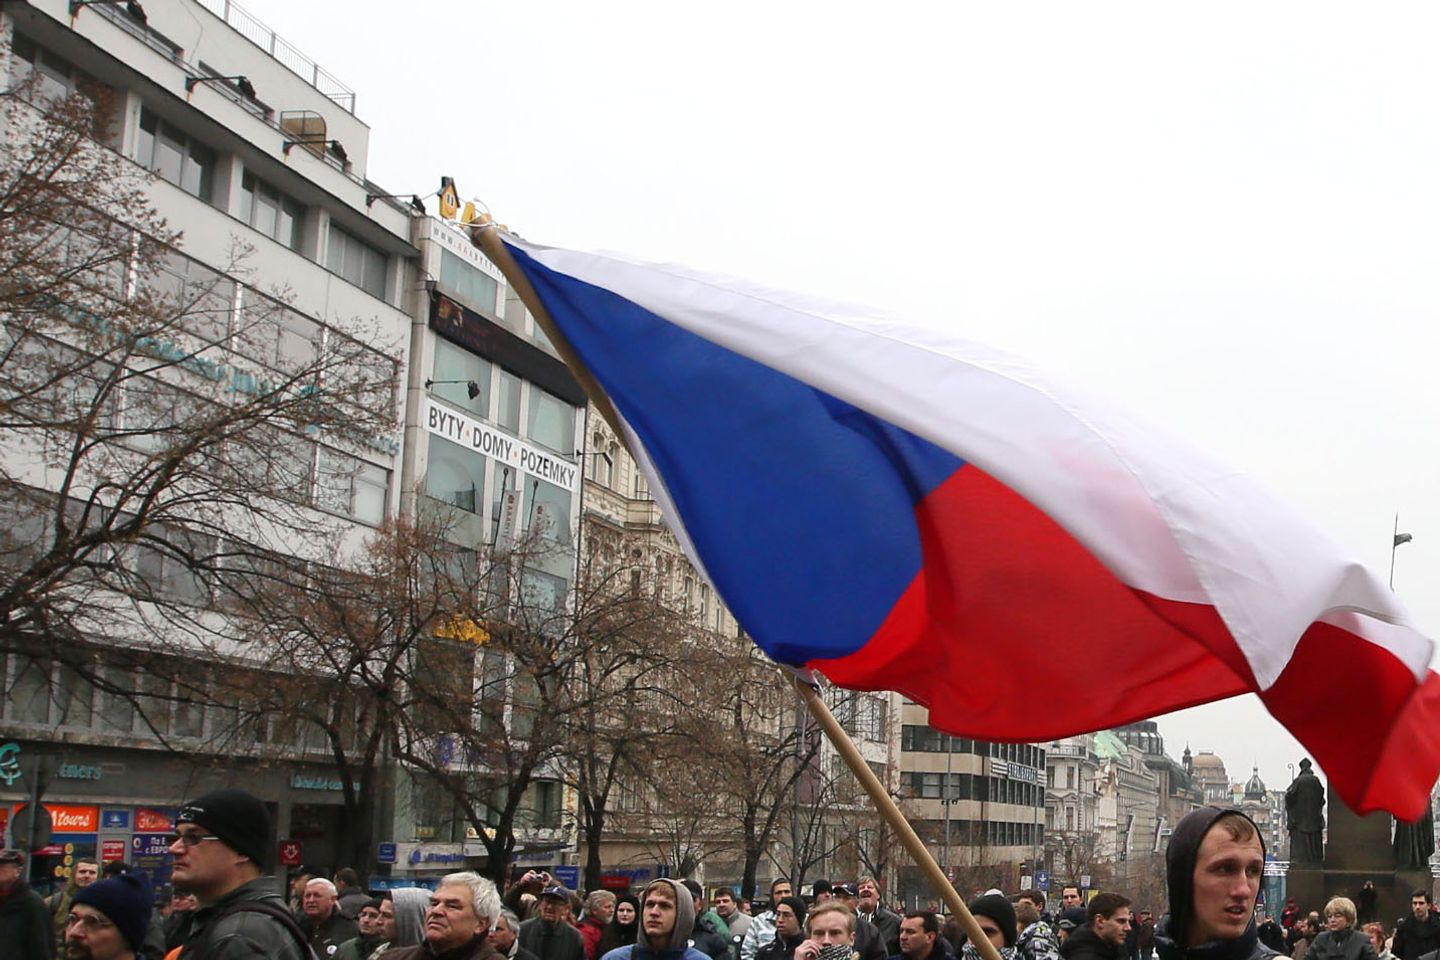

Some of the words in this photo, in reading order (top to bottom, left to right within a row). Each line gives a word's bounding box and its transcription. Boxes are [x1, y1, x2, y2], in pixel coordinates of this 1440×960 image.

[429, 406, 464, 440] BYTY
[472, 427, 512, 461] DOMY
[520, 447, 575, 488] POZEMKY
